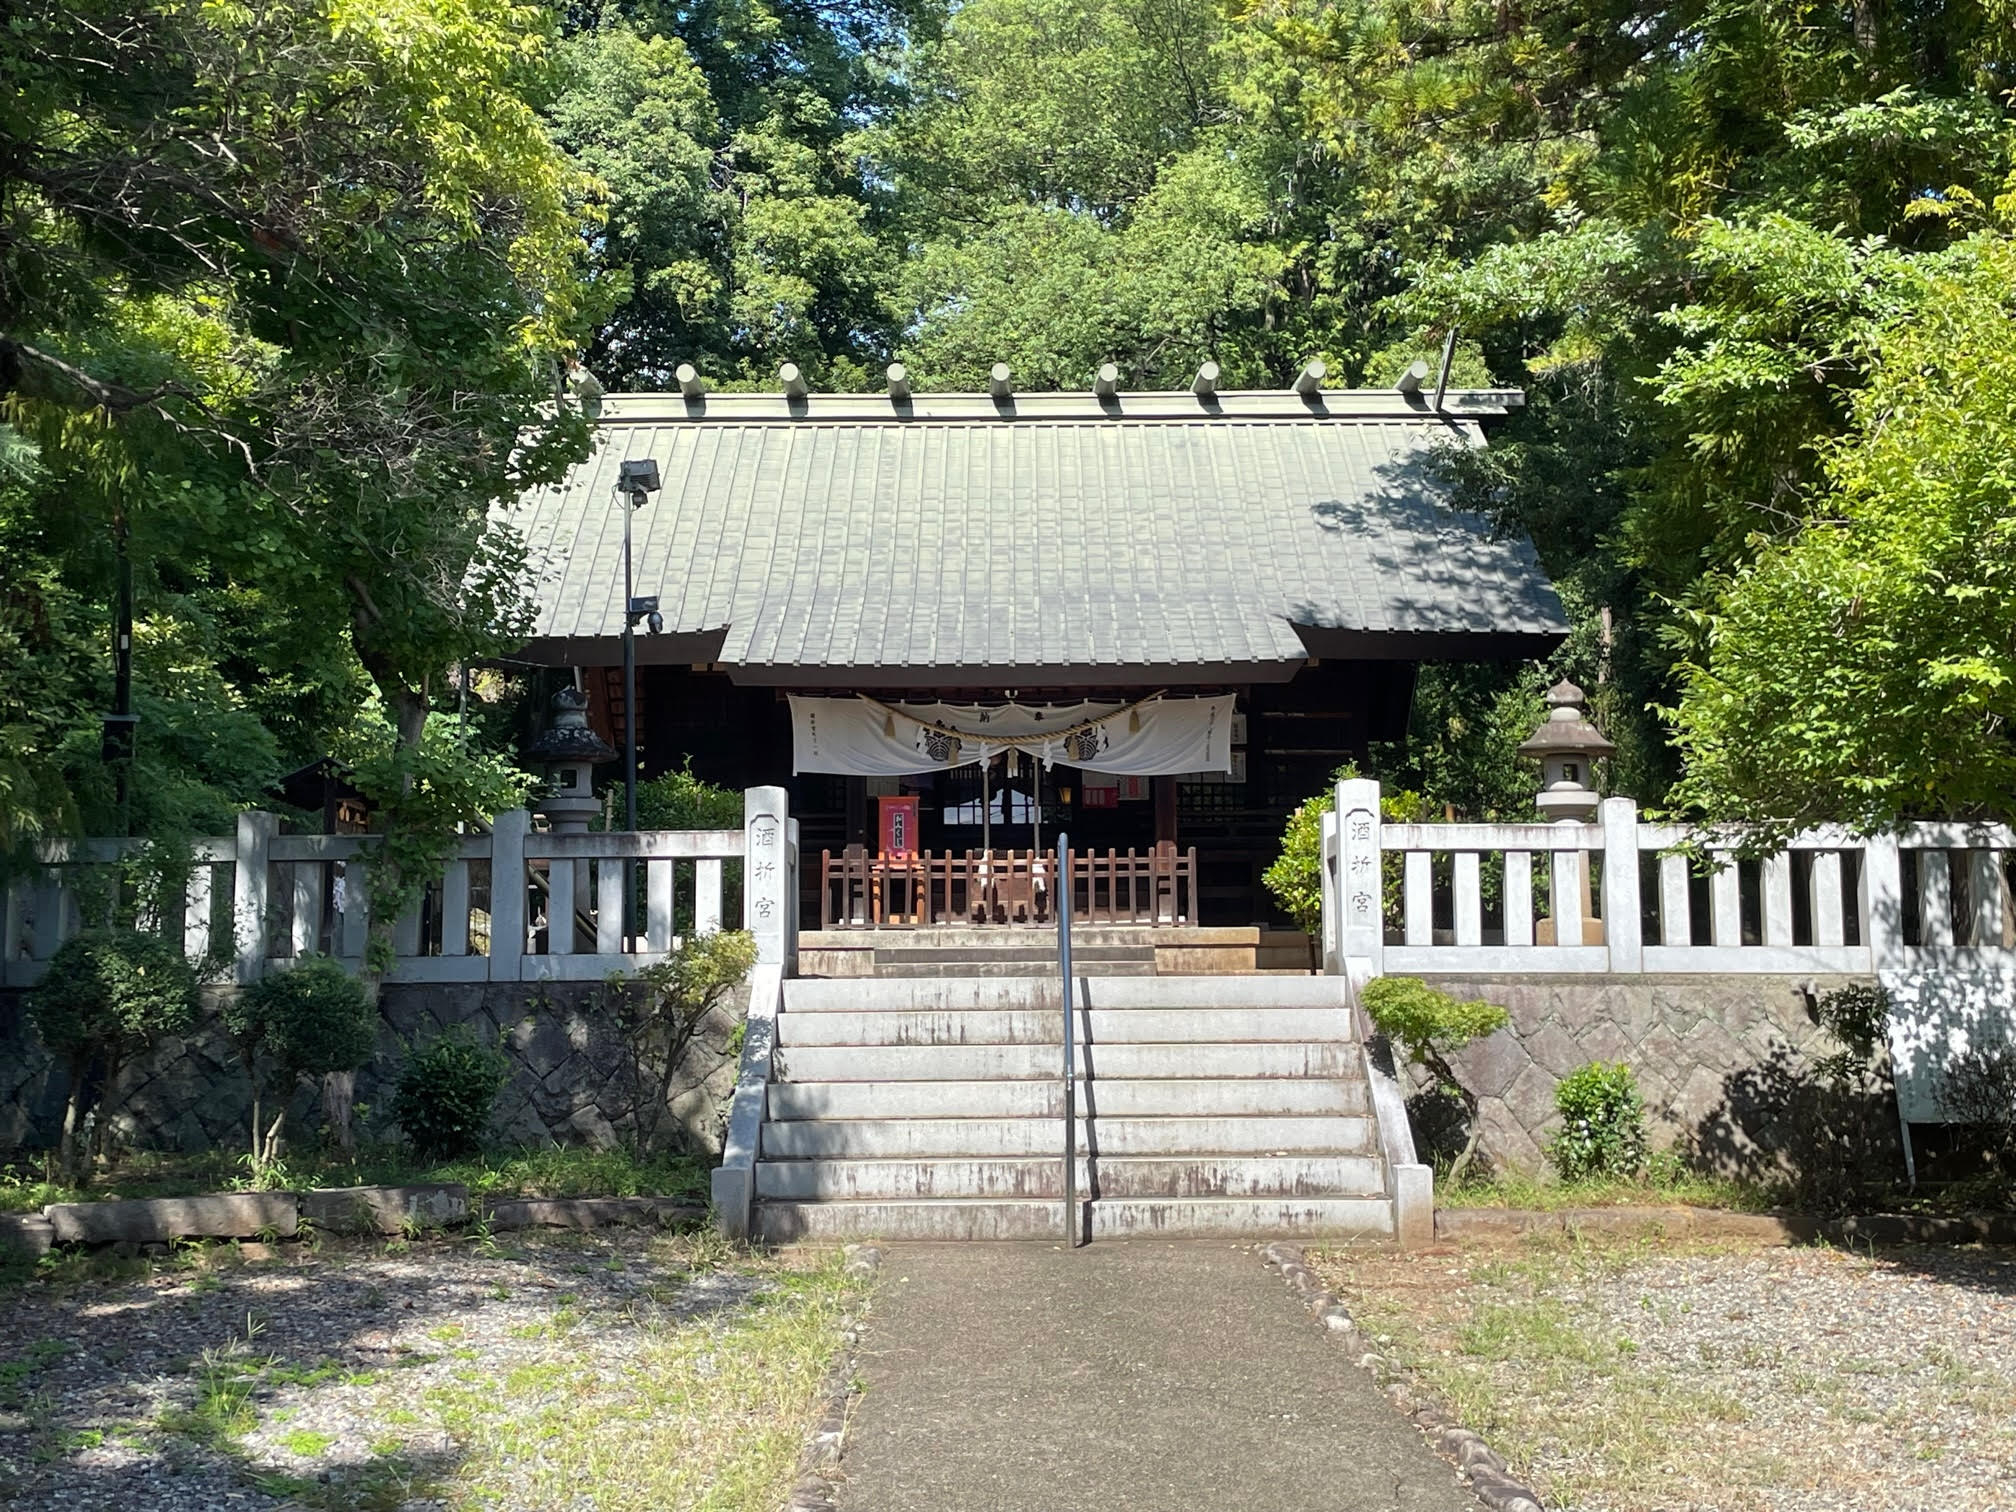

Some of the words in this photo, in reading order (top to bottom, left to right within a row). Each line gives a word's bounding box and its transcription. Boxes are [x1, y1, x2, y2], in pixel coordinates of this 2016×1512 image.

[755, 827, 775, 918] 酒折宮
[1351, 821, 1372, 913] 酒折宮
